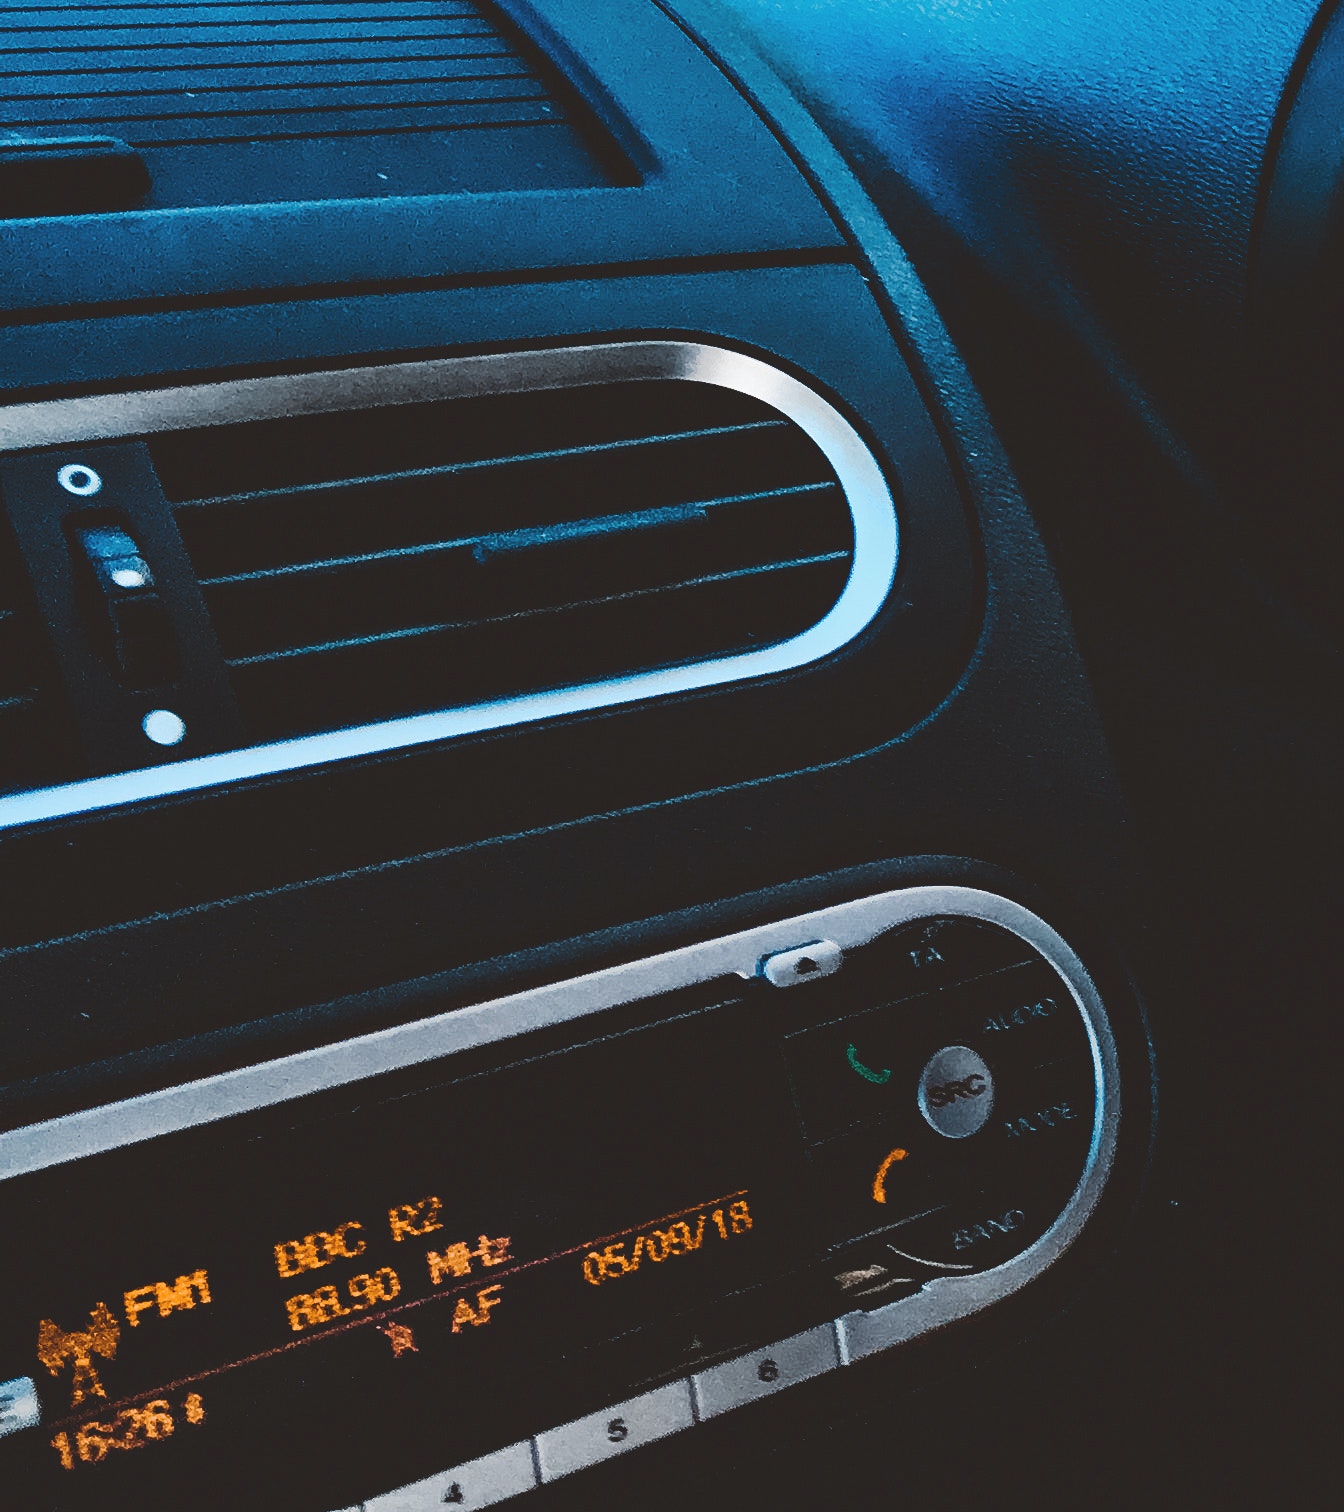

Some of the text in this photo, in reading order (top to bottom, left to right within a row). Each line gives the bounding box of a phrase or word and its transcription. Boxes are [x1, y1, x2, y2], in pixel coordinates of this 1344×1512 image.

[927, 1073, 987, 1107] SRC
[388, 1195, 444, 1242] R2
[426, 1234, 514, 1286] MHz
[123, 1268, 212, 1328] FM1
[451, 1283, 505, 1334] AF
[757, 1358, 779, 1383] 6
[607, 1416, 629, 1443] 5
[440, 1480, 464, 1505] 4
